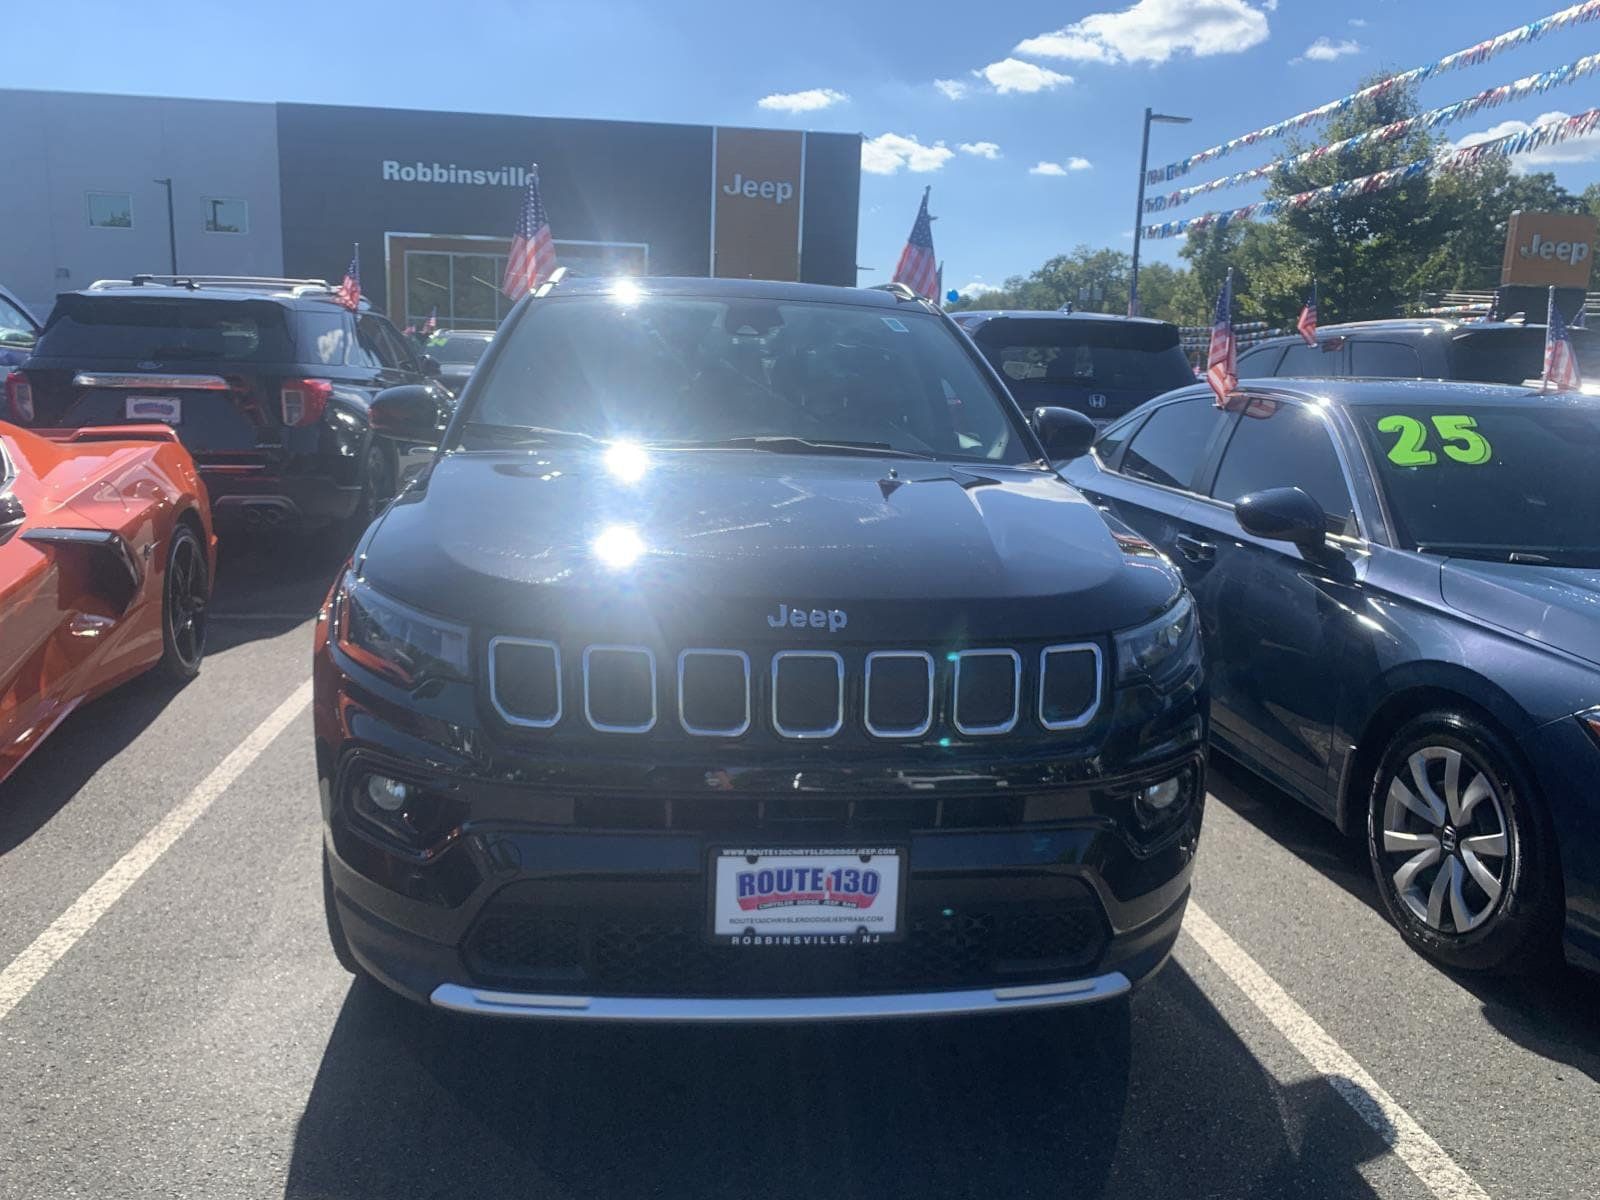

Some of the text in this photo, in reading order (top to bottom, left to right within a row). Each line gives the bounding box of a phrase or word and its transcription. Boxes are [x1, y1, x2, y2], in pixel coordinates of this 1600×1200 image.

[723, 173, 793, 204] Jeep
[1520, 233, 1589, 266] Jeep
[1377, 414, 1493, 468] 25
[767, 603, 849, 633] Jeep
[737, 867, 881, 897] ROUTE 130
[862, 935, 880, 943] NJ
